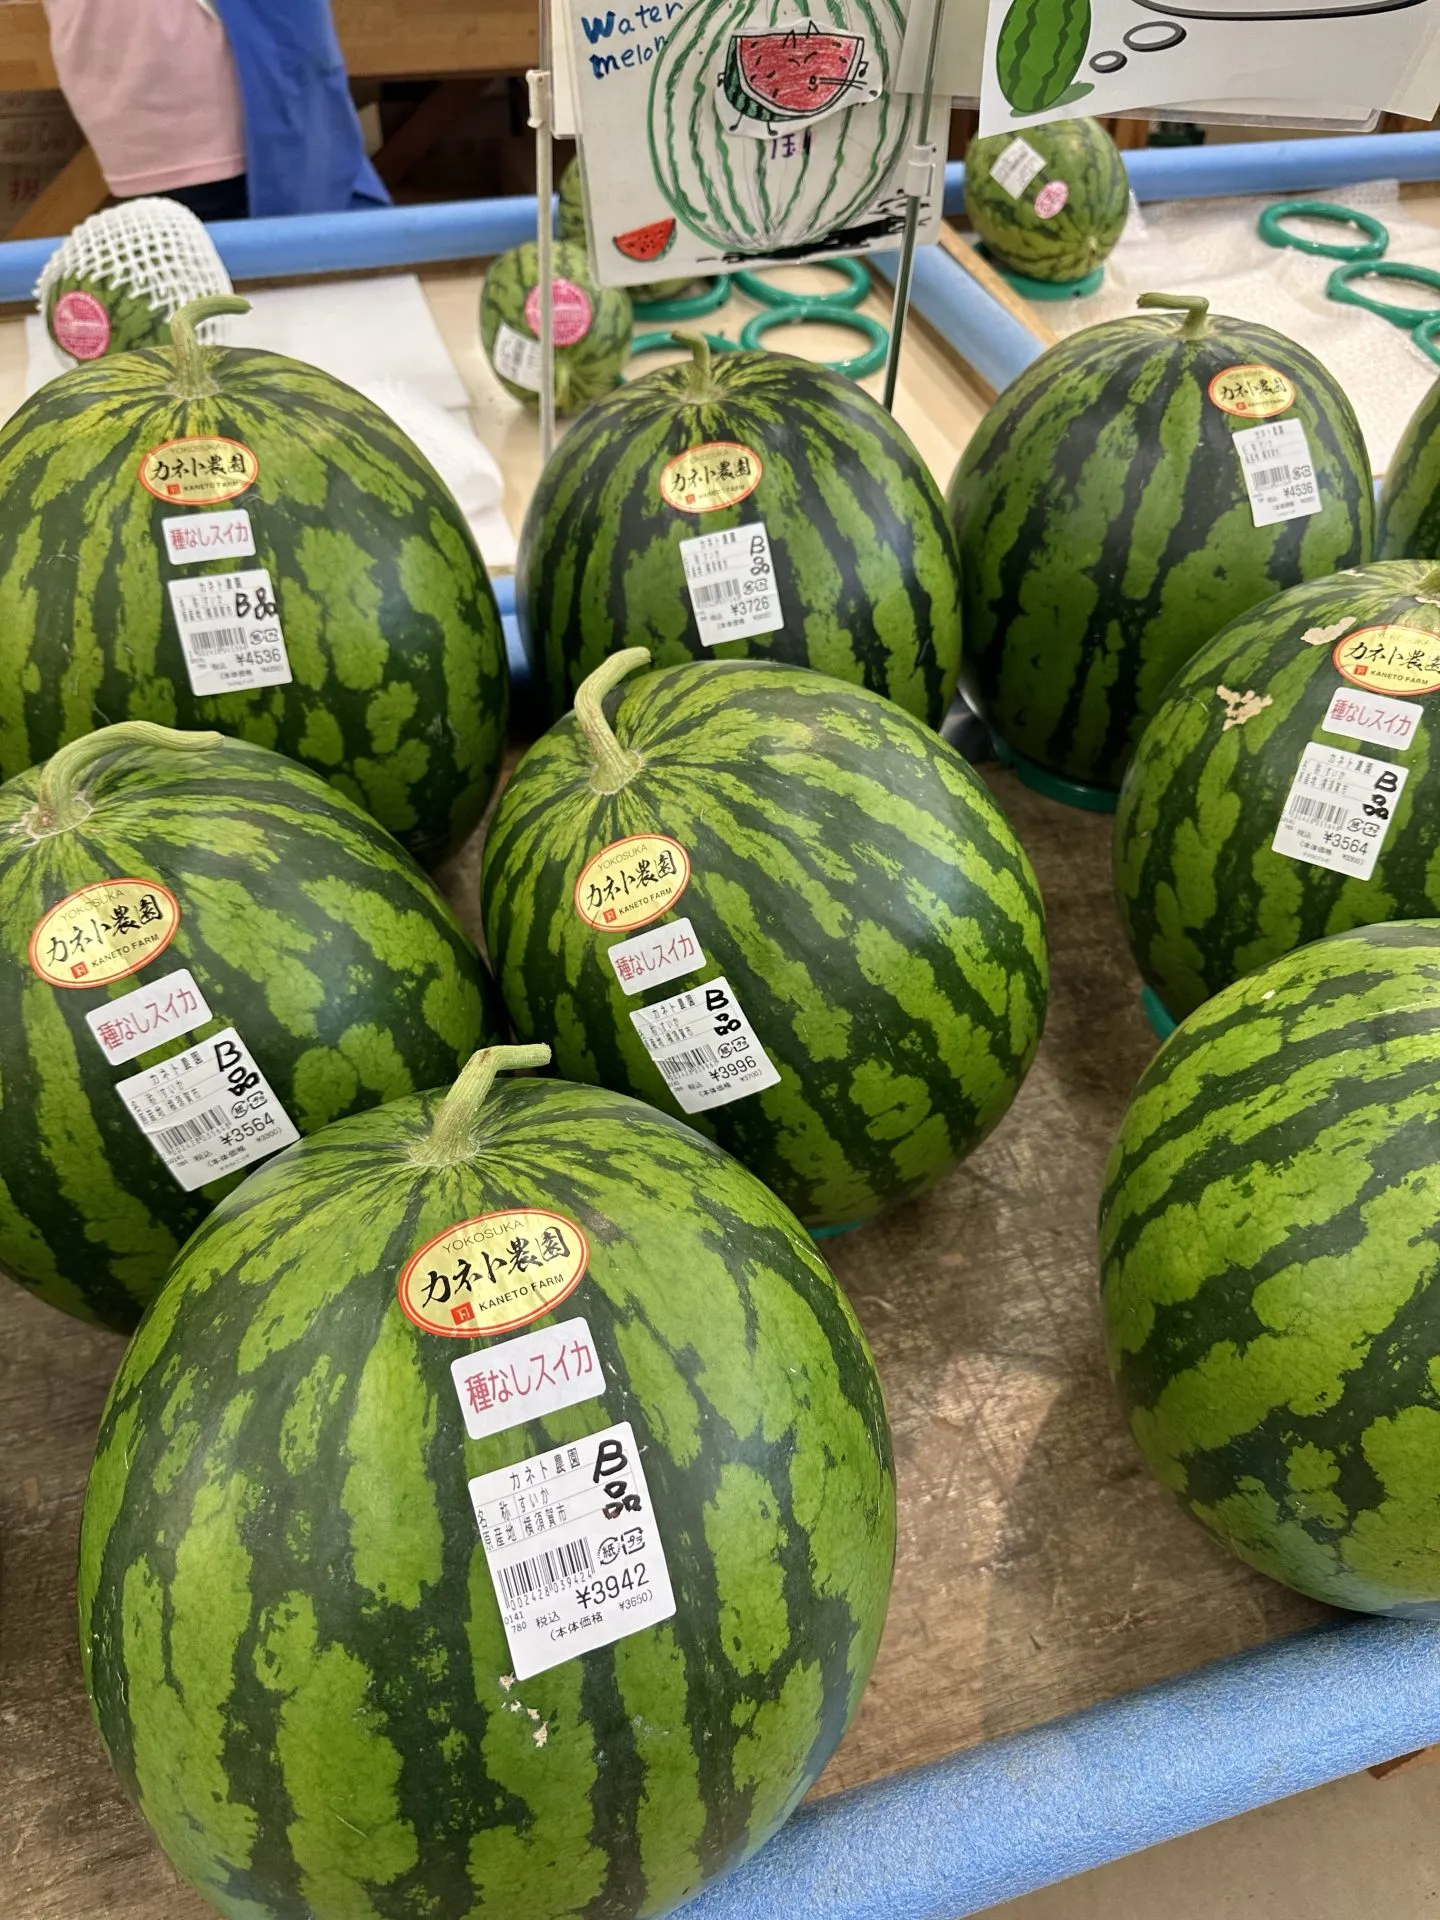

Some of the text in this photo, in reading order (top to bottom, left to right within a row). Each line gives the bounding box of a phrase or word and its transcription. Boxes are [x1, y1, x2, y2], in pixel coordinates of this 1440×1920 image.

[581, 2, 683, 44] Water
[589, 35, 668, 79] melon
[150, 453, 246, 481] カネト農園
[671, 457, 751, 492] カネト農園
[1283, 482, 1313, 498] ¥4536
[170, 521, 249, 551] 種なしスイカ
[730, 597, 770, 616] ¥3726
[236, 648, 281, 666] ¥4536
[1370, 670, 1429, 685] KANETO FARM
[1330, 699, 1412, 736] 種なしスイカ
[597, 844, 648, 871] YOKOSUKA
[1323, 831, 1369, 856] ¥3564
[586, 849, 677, 911] カネト農園
[60, 889, 125, 921] YOKOSUKA
[618, 887, 673, 915] KANETO FARM
[46, 894, 164, 967] カネト農園
[91, 934, 160, 968] KANETO FARM
[615, 934, 694, 981] 種なしスイカ
[97, 988, 198, 1050] 種なしスイカ
[652, 994, 695, 1019] カネト農園
[705, 989, 742, 1036] B品
[150, 1051, 204, 1086] カネト農園
[214, 1040, 260, 1097] B品
[709, 1055, 757, 1082] ¥3996
[219, 1112, 275, 1147] ¥3564
[442, 1219, 524, 1254] YOKOSUKA
[421, 1226, 571, 1308] カネト農園
[478, 1273, 564, 1311] KANETO FARM
[464, 1340, 593, 1414] 種なしスイカ
[509, 1447, 580, 1491] カネト農園
[593, 1439, 642, 1520] B品
[518, 1486, 549, 1513] すいか
[523, 1503, 567, 1536] 横須賀市
[535, 1562, 649, 1629] 税込 ¥3942
[504, 1610, 525, 1625] 0141
[511, 1621, 527, 1633] 780
[550, 1589, 653, 1641] (本体価格 ¥3650)
